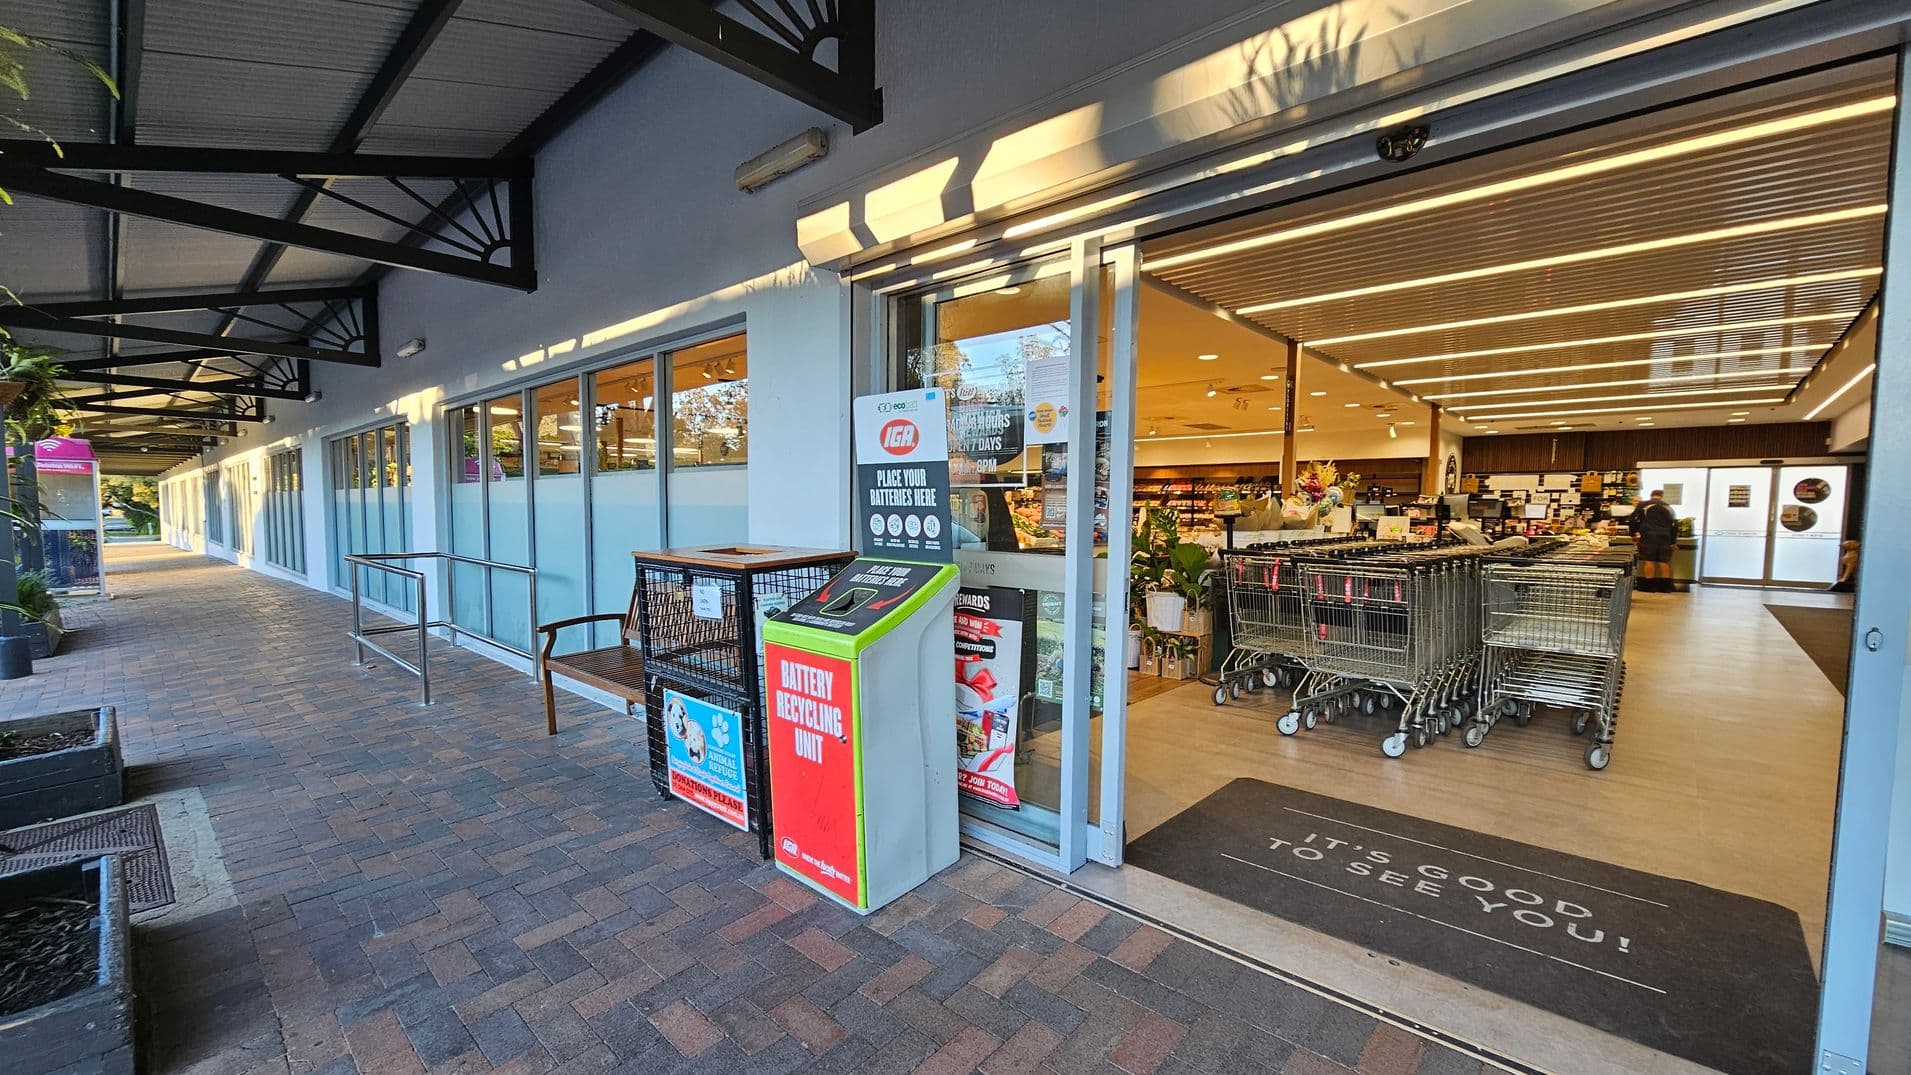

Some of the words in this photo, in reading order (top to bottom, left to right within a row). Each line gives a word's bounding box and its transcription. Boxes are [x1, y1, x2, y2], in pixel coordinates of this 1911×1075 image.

[884, 425, 915, 448] IGA
[978, 437, 1002, 451] DAYS
[976, 459, 997, 473] 8PM
[877, 469, 902, 487] PLACE
[903, 468, 926, 487] YOUR
[870, 488, 913, 506] BATTERIES
[914, 488, 936, 507] HERE
[850, 574, 890, 585] BATTERIES
[883, 577, 909, 587] HERE
[866, 565, 893, 575] PLACE
[888, 567, 912, 577] YOUR
[954, 593, 990, 610] REWARDS
[969, 619, 982, 630] WIN
[956, 641, 994, 653] COMPETITIONS
[781, 660, 833, 701] BATTERY
[776, 690, 842, 738] RECYCLING
[794, 727, 823, 764] UNIT
[708, 751, 737, 769] ANIMAL
[709, 761, 738, 781] REFUGE
[670, 770, 712, 798] DONATIONS
[713, 790, 744, 813] PLEASE
[968, 776, 985, 787] JOIN
[987, 780, 1008, 797] TODAY!
[1304, 832, 1392, 865] IT'S
[1416, 864, 1593, 919] GOOD
[1268, 837, 1324, 862] TO
[1345, 862, 1445, 898] SEE
[1475, 895, 1631, 954] YOU!
